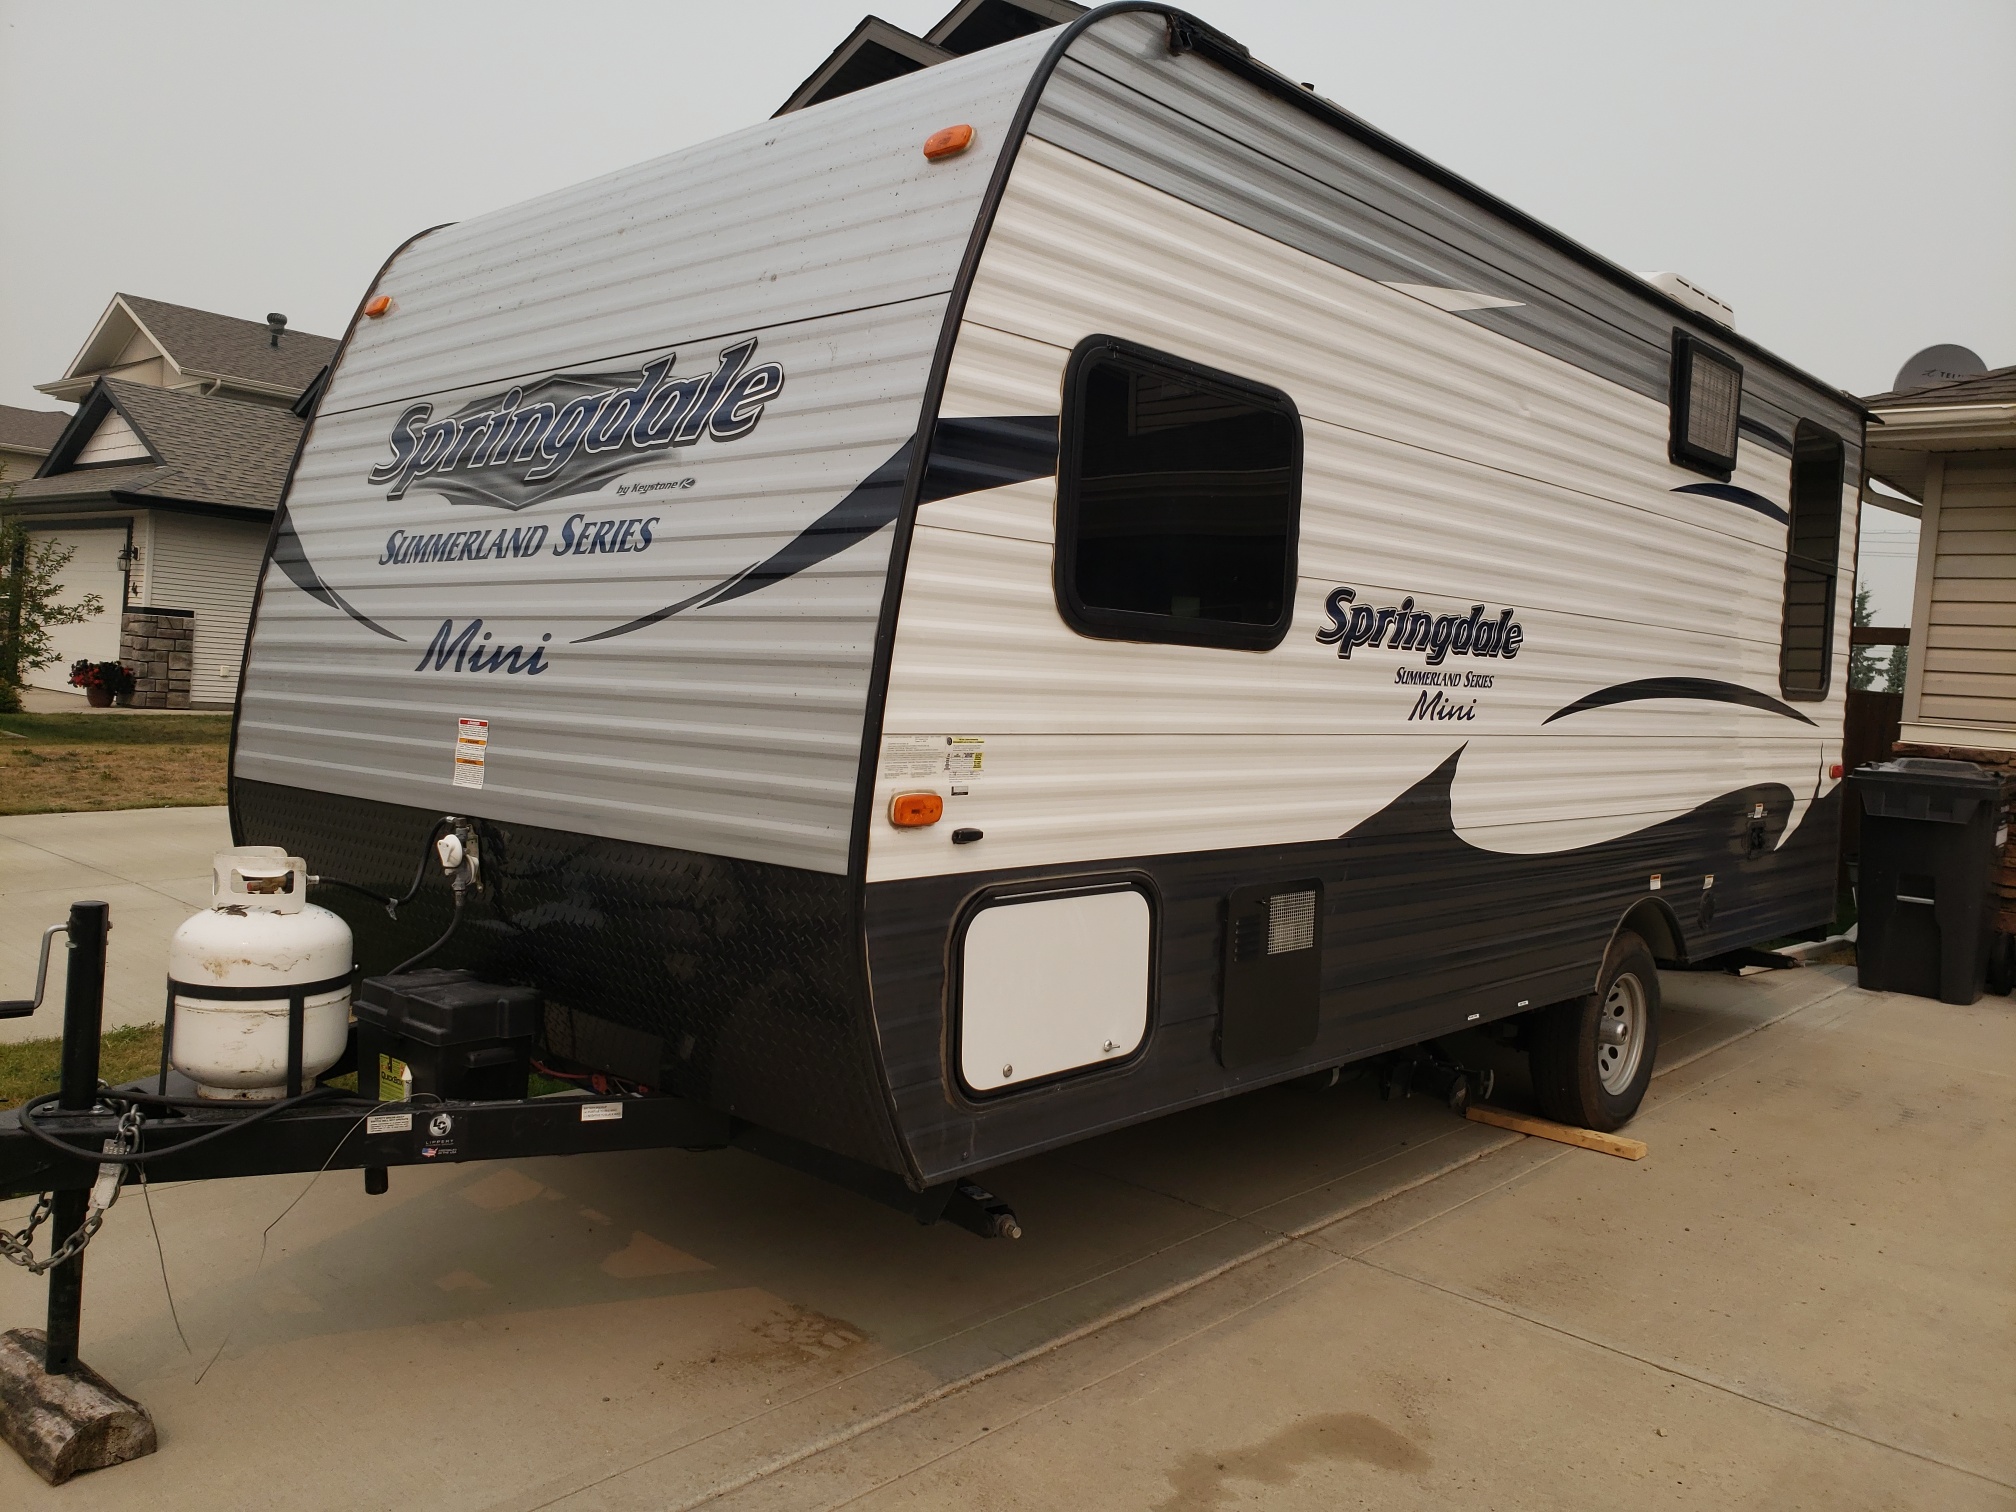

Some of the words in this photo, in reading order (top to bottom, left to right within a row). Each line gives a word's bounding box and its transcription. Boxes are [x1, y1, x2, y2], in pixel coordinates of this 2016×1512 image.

[368, 336, 785, 501] Springdale
[615, 484, 631, 496] by
[632, 481, 679, 494] Keystone
[378, 523, 549, 566] SUMMERLAND
[552, 513, 661, 558] SERIES
[415, 618, 552, 675] Mini
[1314, 586, 1524, 666] Springdale
[1394, 666, 1462, 687] SUMMERLAND
[1463, 670, 1494, 688] SERIES
[1407, 689, 1477, 721] Mini
